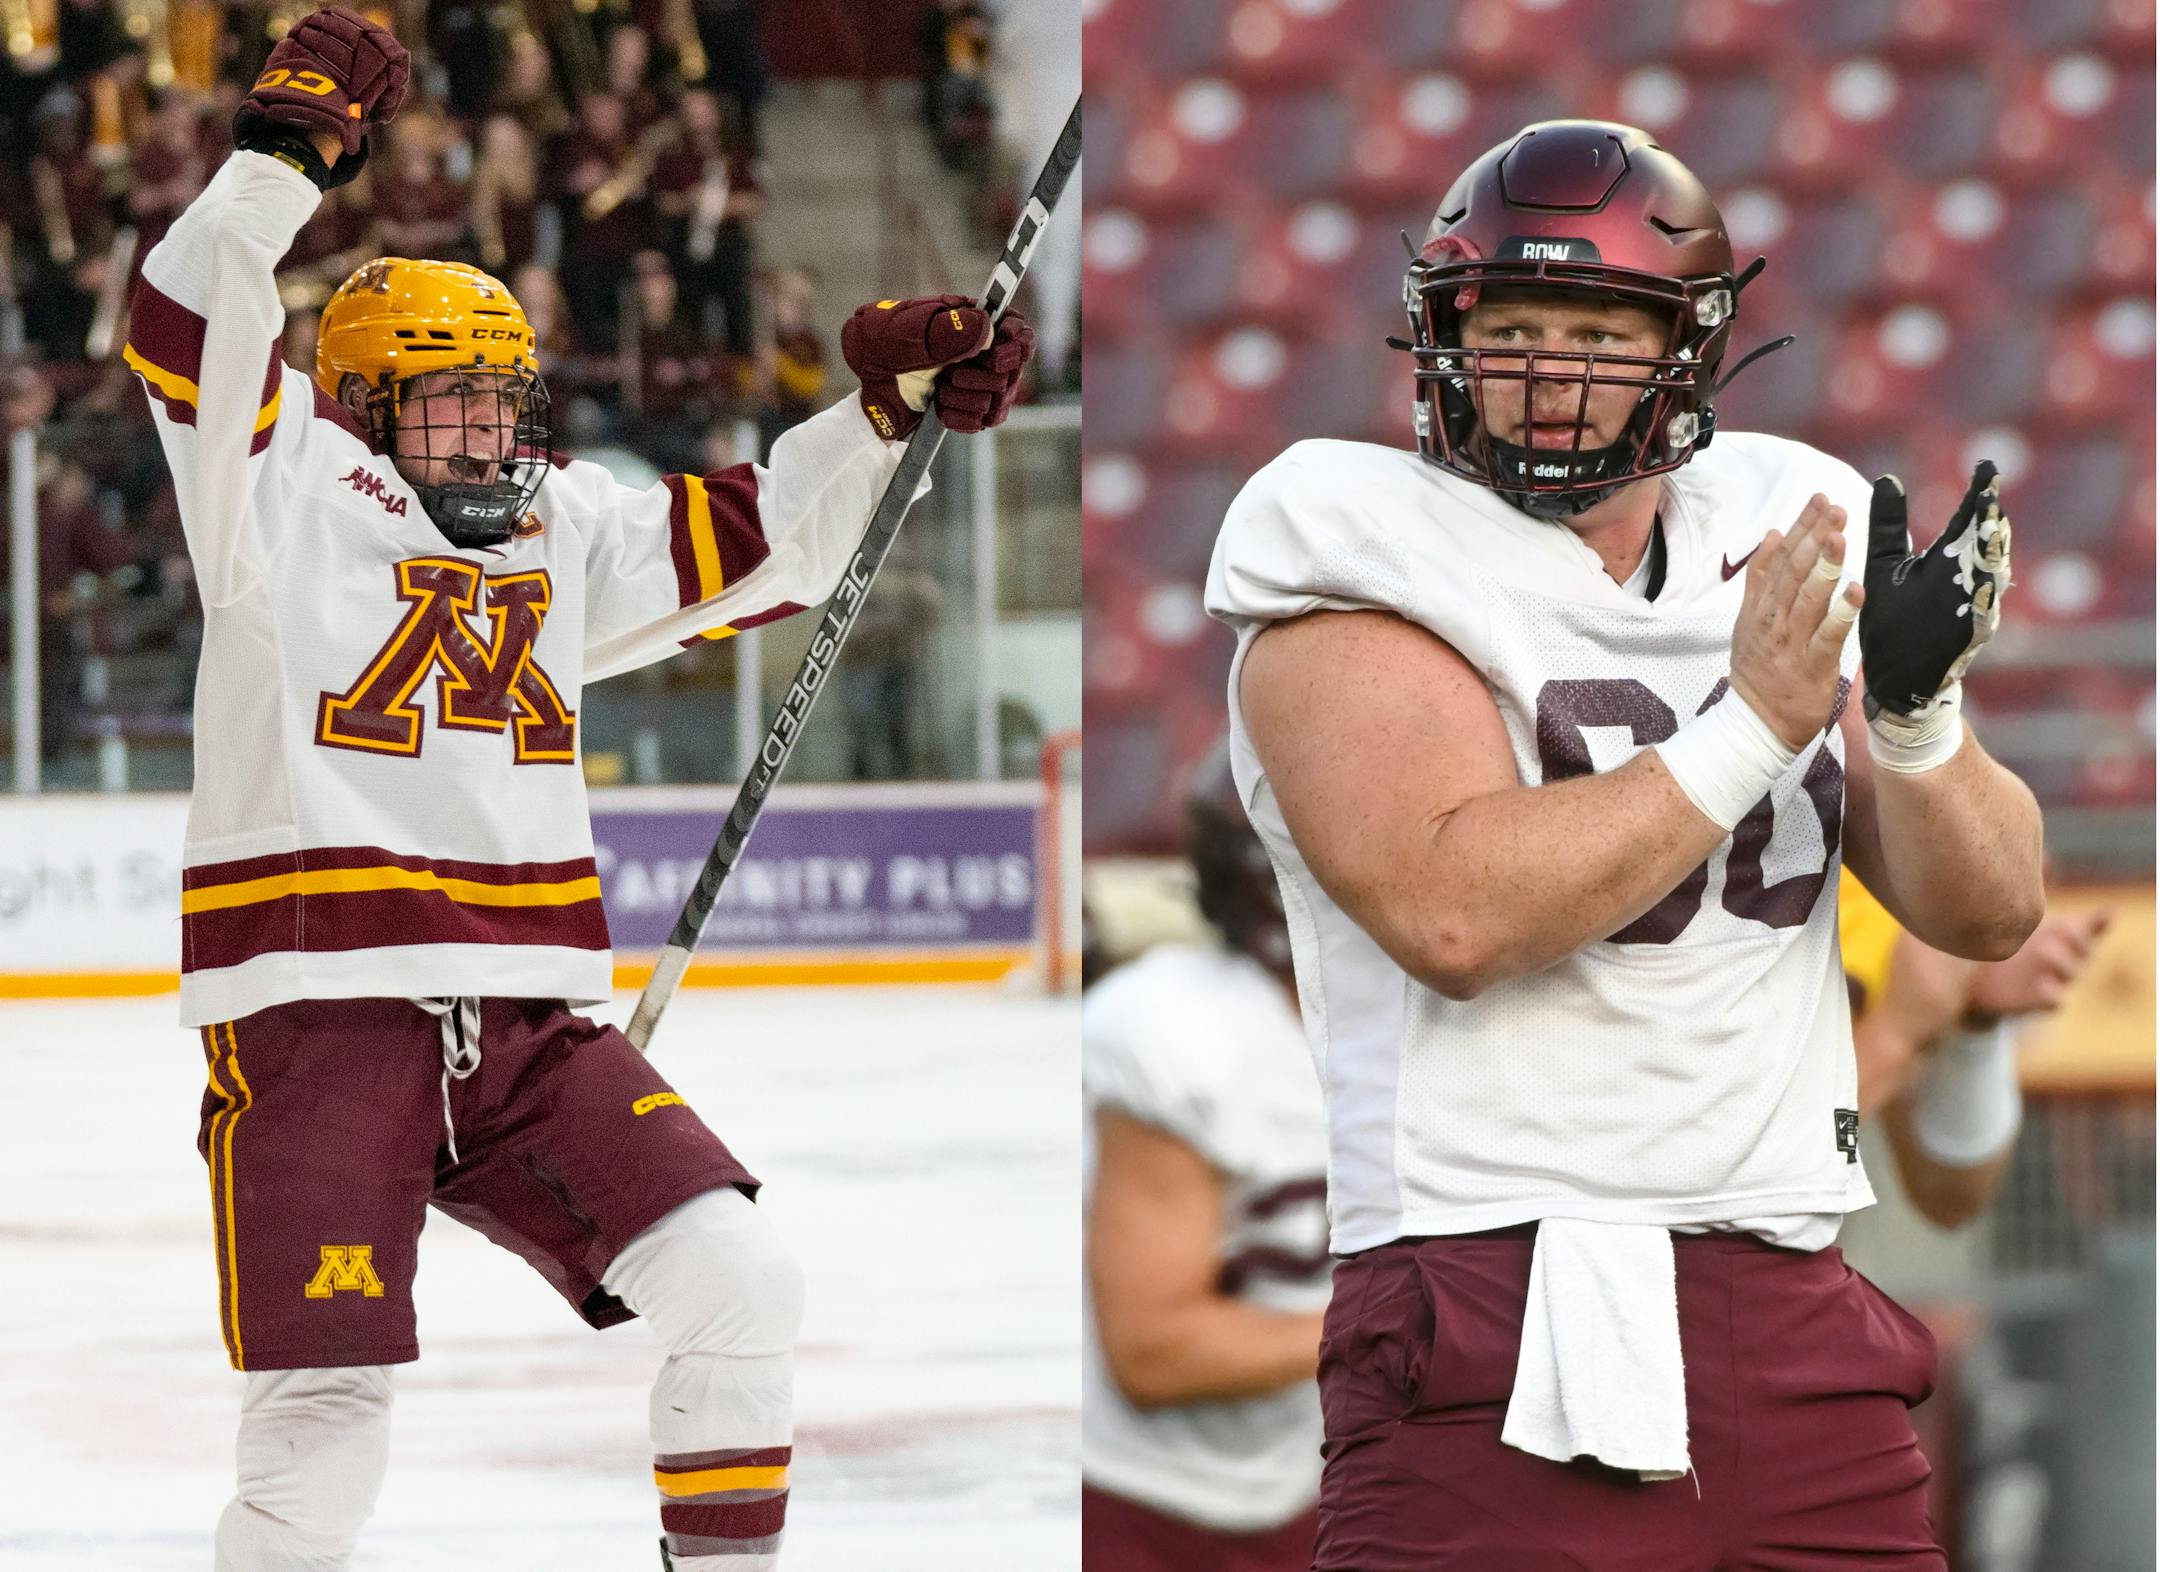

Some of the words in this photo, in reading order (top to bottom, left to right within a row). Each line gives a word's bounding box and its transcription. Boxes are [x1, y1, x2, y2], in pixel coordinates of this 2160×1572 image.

[471, 328, 523, 342] CCM
[867, 405, 893, 437] CCM
[1518, 461, 1570, 478] Rddel
[314, 555, 576, 765] M
[762, 551, 869, 768] JETSPEED
[888, 854, 1033, 908] PLUS
[305, 1245, 384, 1298] M
